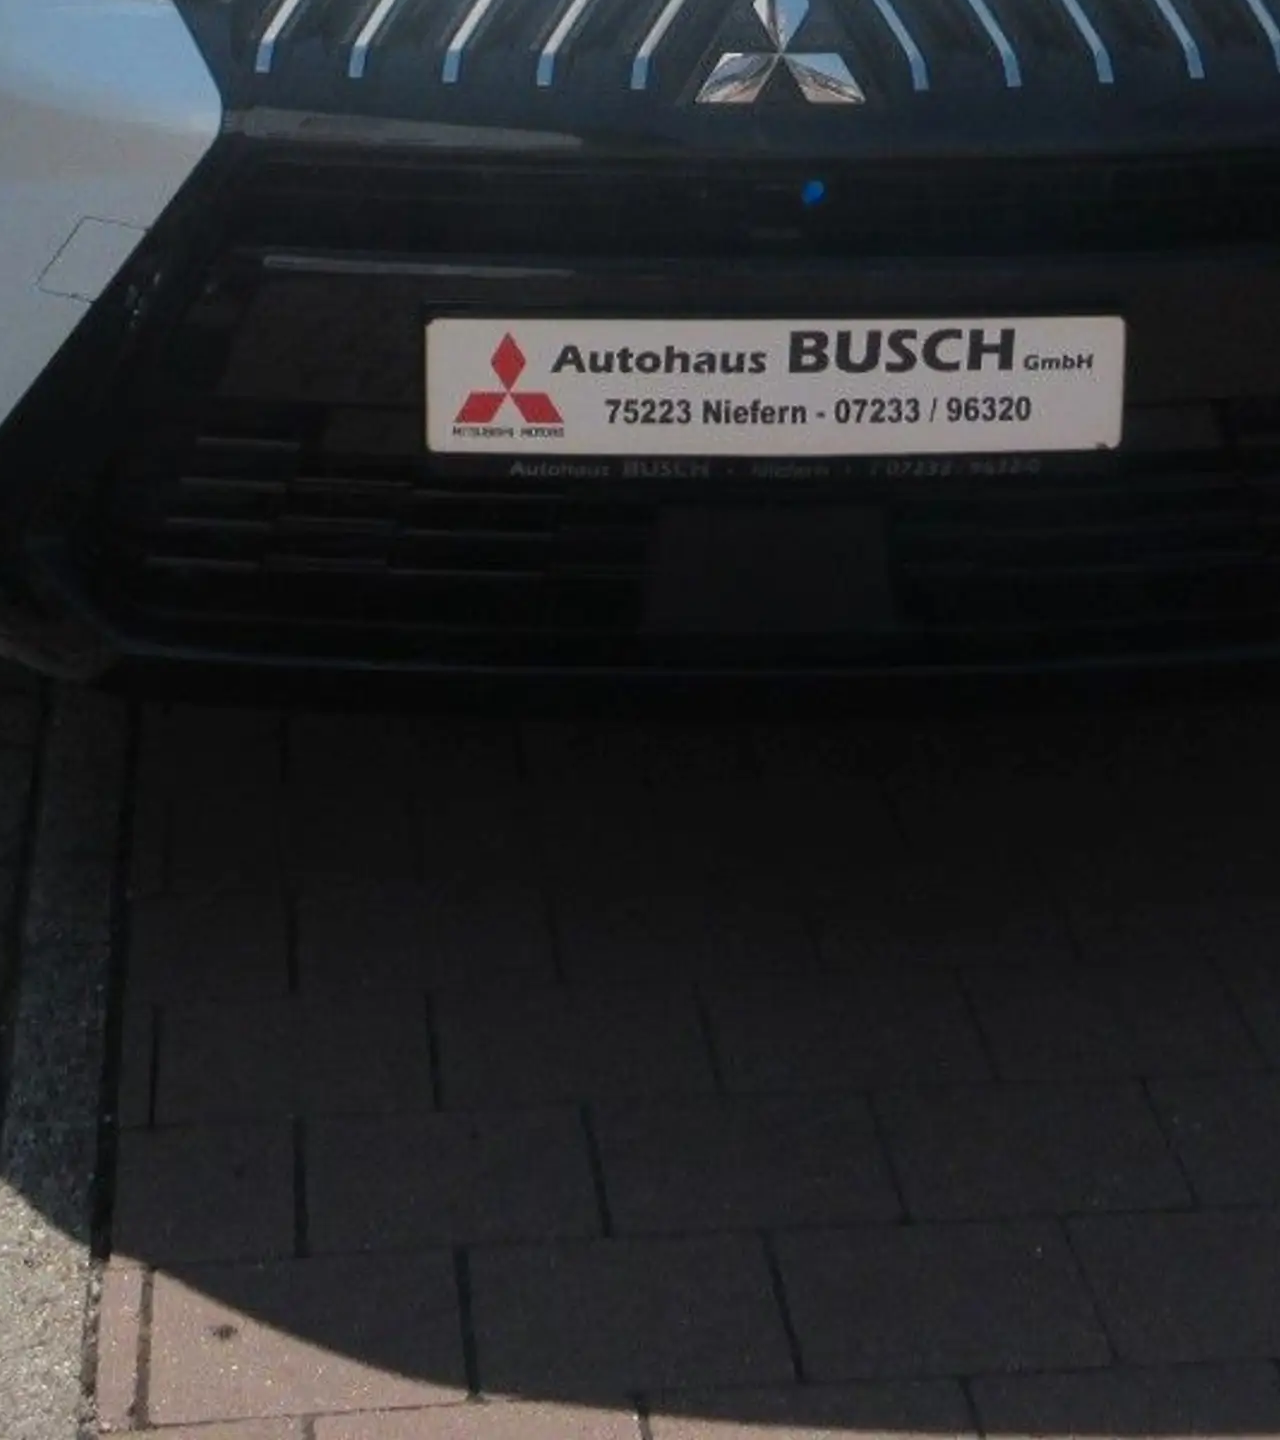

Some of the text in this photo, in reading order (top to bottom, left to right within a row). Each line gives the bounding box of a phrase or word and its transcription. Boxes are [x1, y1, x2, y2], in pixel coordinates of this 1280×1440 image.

[549, 328, 1095, 374] Autohaus BUSCH GmbH
[604, 398, 692, 425] 75223
[702, 398, 807, 425] Niefern
[834, 397, 921, 424] 07233
[928, 397, 939, 423] /
[946, 395, 1032, 422] 96320
